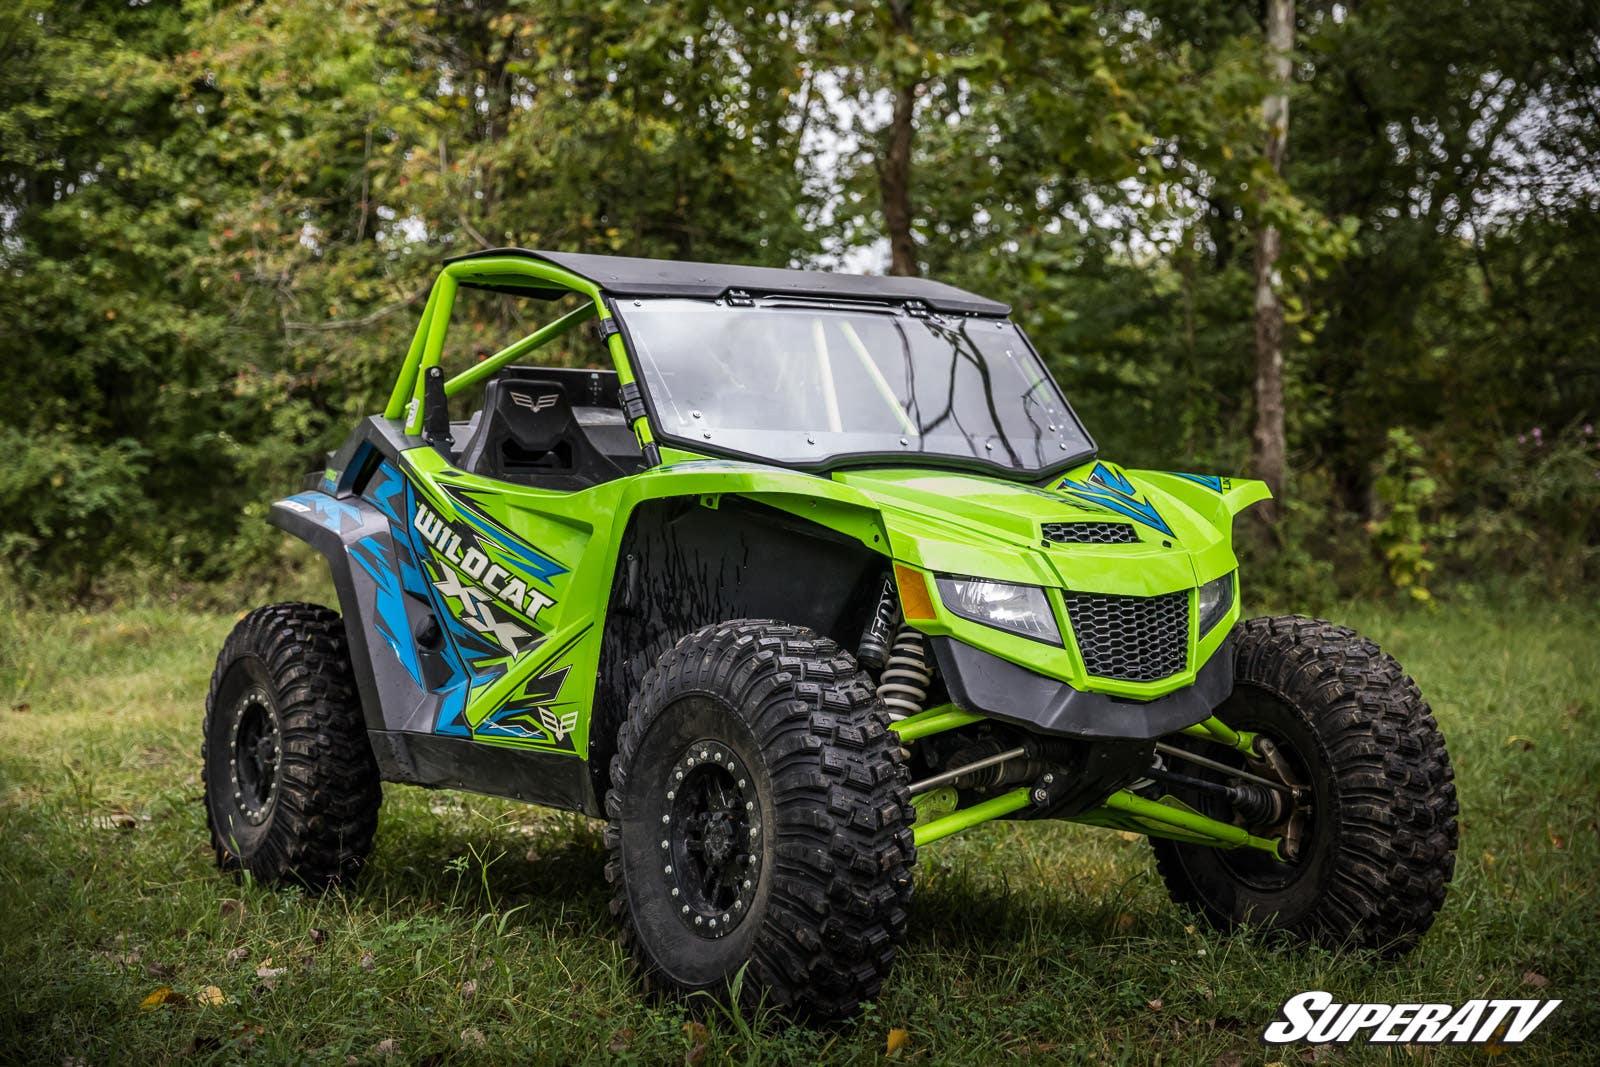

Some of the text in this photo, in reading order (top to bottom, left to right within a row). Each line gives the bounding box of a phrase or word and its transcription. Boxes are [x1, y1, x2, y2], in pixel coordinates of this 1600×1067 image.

[413, 502, 558, 621] WILDCAT
[432, 560, 533, 661] XX
[871, 576, 898, 644] FOX
